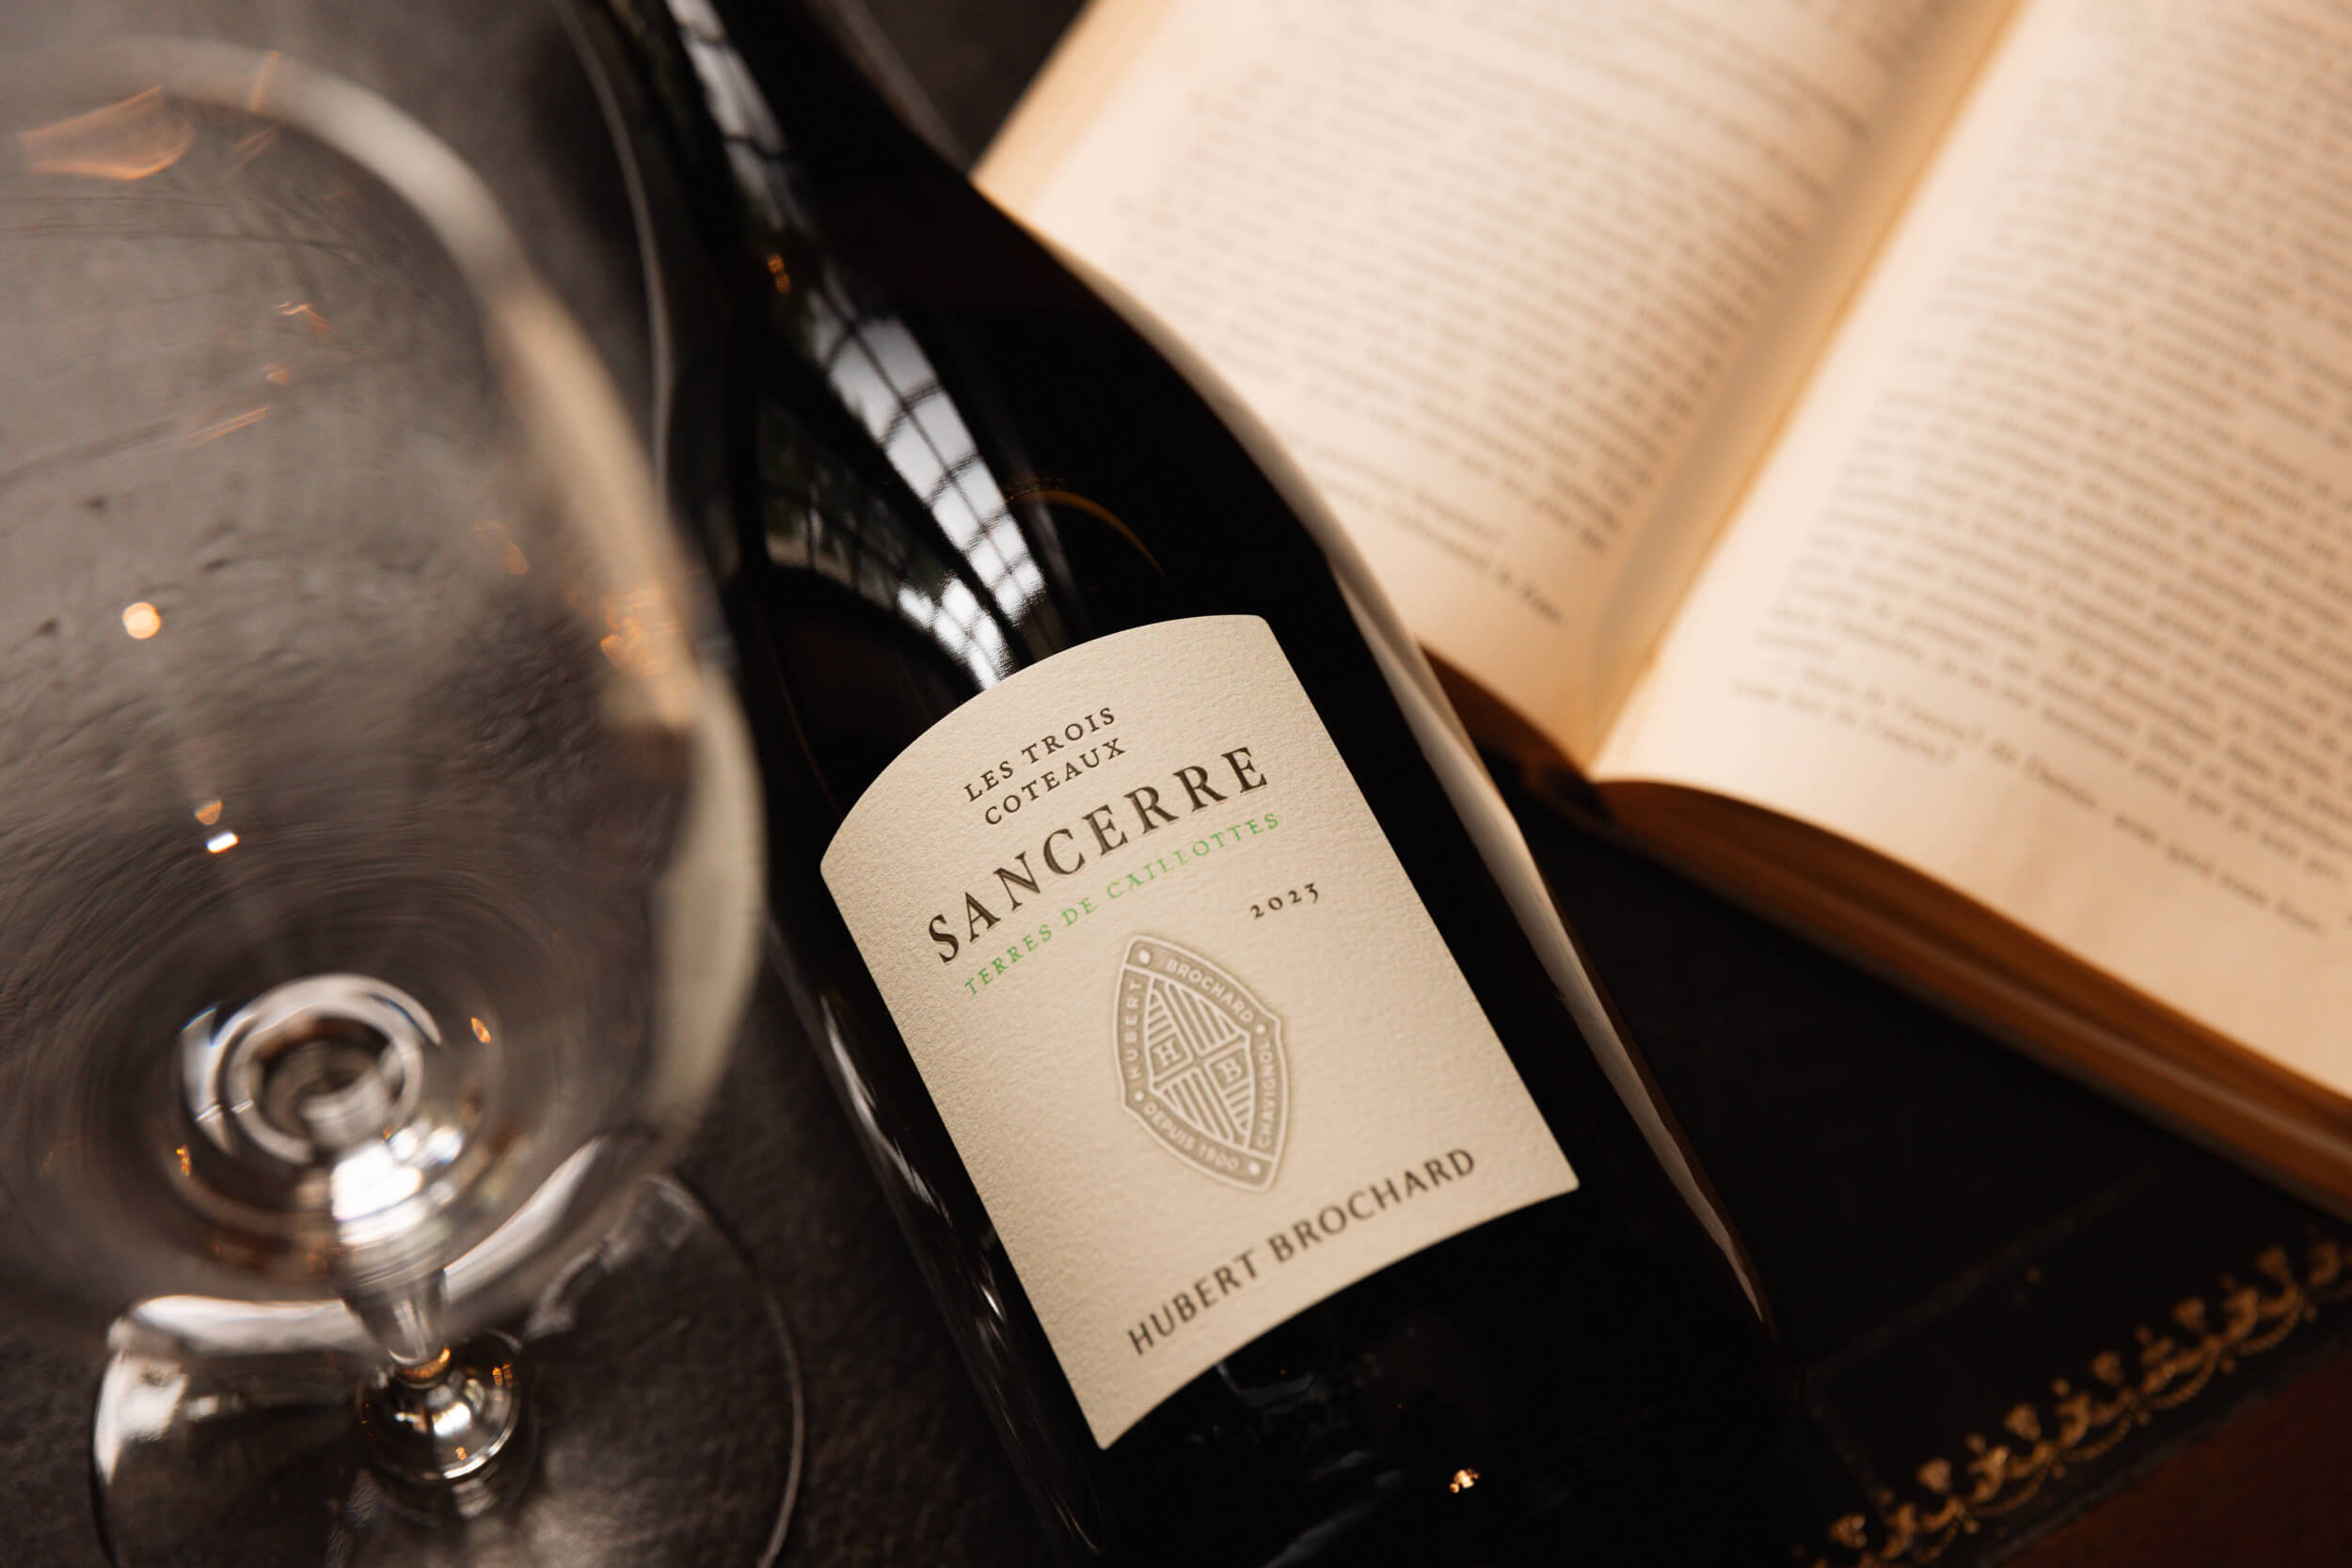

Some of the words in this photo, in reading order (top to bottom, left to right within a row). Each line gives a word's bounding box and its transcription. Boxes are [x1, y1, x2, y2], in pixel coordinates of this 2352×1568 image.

[963, 761, 1014, 802] LES
[1022, 707, 1116, 764] TROIS
[984, 737, 1126, 825] COTEAUX
[929, 747, 1268, 963] SANCERRE
[1249, 882, 1319, 919] 2023
[964, 924, 1053, 995] TERRES
[1061, 897, 1098, 927] DE
[1106, 813, 1280, 900] CAILLOTTES
[1124, 980, 1143, 1080] HUBERT
[1166, 958, 1254, 1023] BROCHARD
[1153, 1038, 1181, 1066] H
[1220, 1057, 1243, 1083] B
[1256, 1038, 1276, 1148] CHAVIGNOL
[1143, 1101, 1198, 1152] DEPUIS
[1127, 1248, 1262, 1355] HUBERT
[1266, 1148, 1476, 1263] BROCHARD
